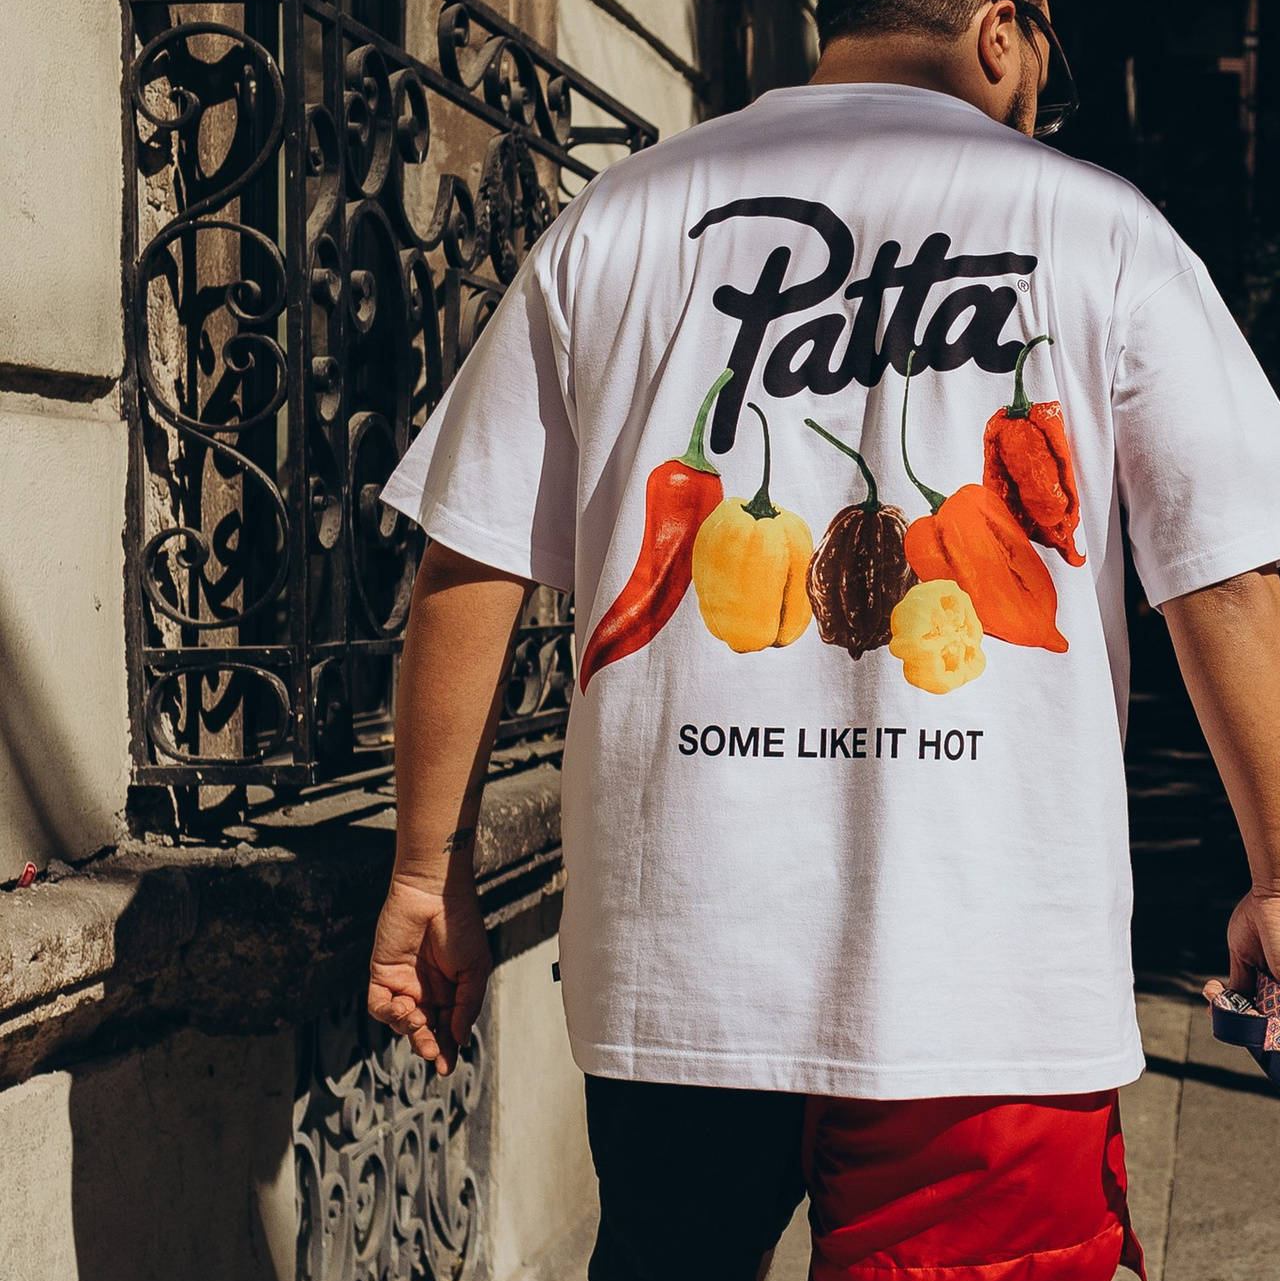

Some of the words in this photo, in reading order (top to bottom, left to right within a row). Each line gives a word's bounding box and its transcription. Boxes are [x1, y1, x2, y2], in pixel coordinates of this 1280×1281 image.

[688, 196, 1039, 455] Patta
[678, 724, 785, 758] SOME
[797, 727, 868, 759] LIKE
[875, 727, 907, 760] IT
[918, 728, 984, 761] HOT
